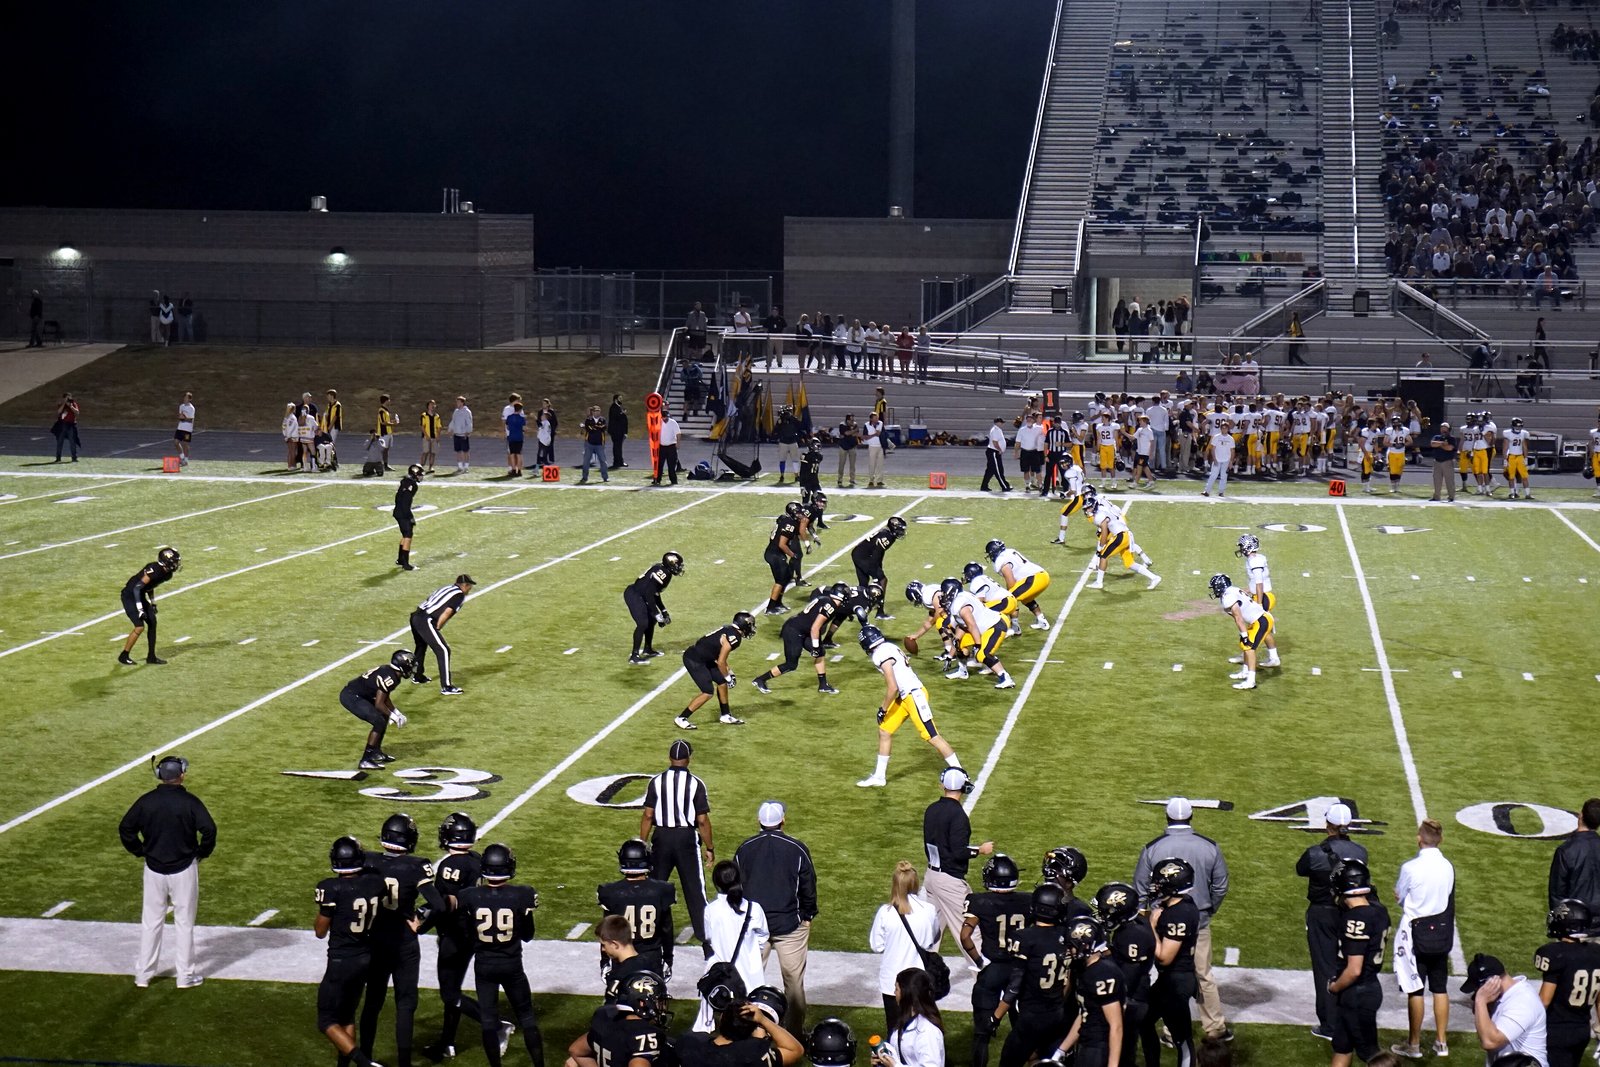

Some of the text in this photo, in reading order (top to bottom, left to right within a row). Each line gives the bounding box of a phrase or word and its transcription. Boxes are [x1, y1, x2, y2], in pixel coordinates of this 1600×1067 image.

[1046, 392, 1054, 407] 1
[1101, 431, 1111, 440] 62
[545, 467, 558, 479] 20
[933, 475, 946, 487] 30
[1329, 481, 1343, 494] 40
[656, 568, 667, 580] 20
[823, 602, 835, 615] 90
[383, 675, 395, 688] 10
[442, 866, 461, 882] 64
[314, 887, 325, 903] 31
[350, 898, 378, 933] 31
[623, 904, 657, 939] 48
[475, 907, 514, 943] 29
[1167, 923, 1186, 937] 32
[1346, 920, 1366, 934] 52
[1007, 938, 1020, 953] 34
[1128, 944, 1138, 958] 6
[1534, 955, 1550, 971] 86
[1096, 979, 1115, 996] 27
[1568, 969, 1600, 1008] 86
[635, 1032, 658, 1051] 75
